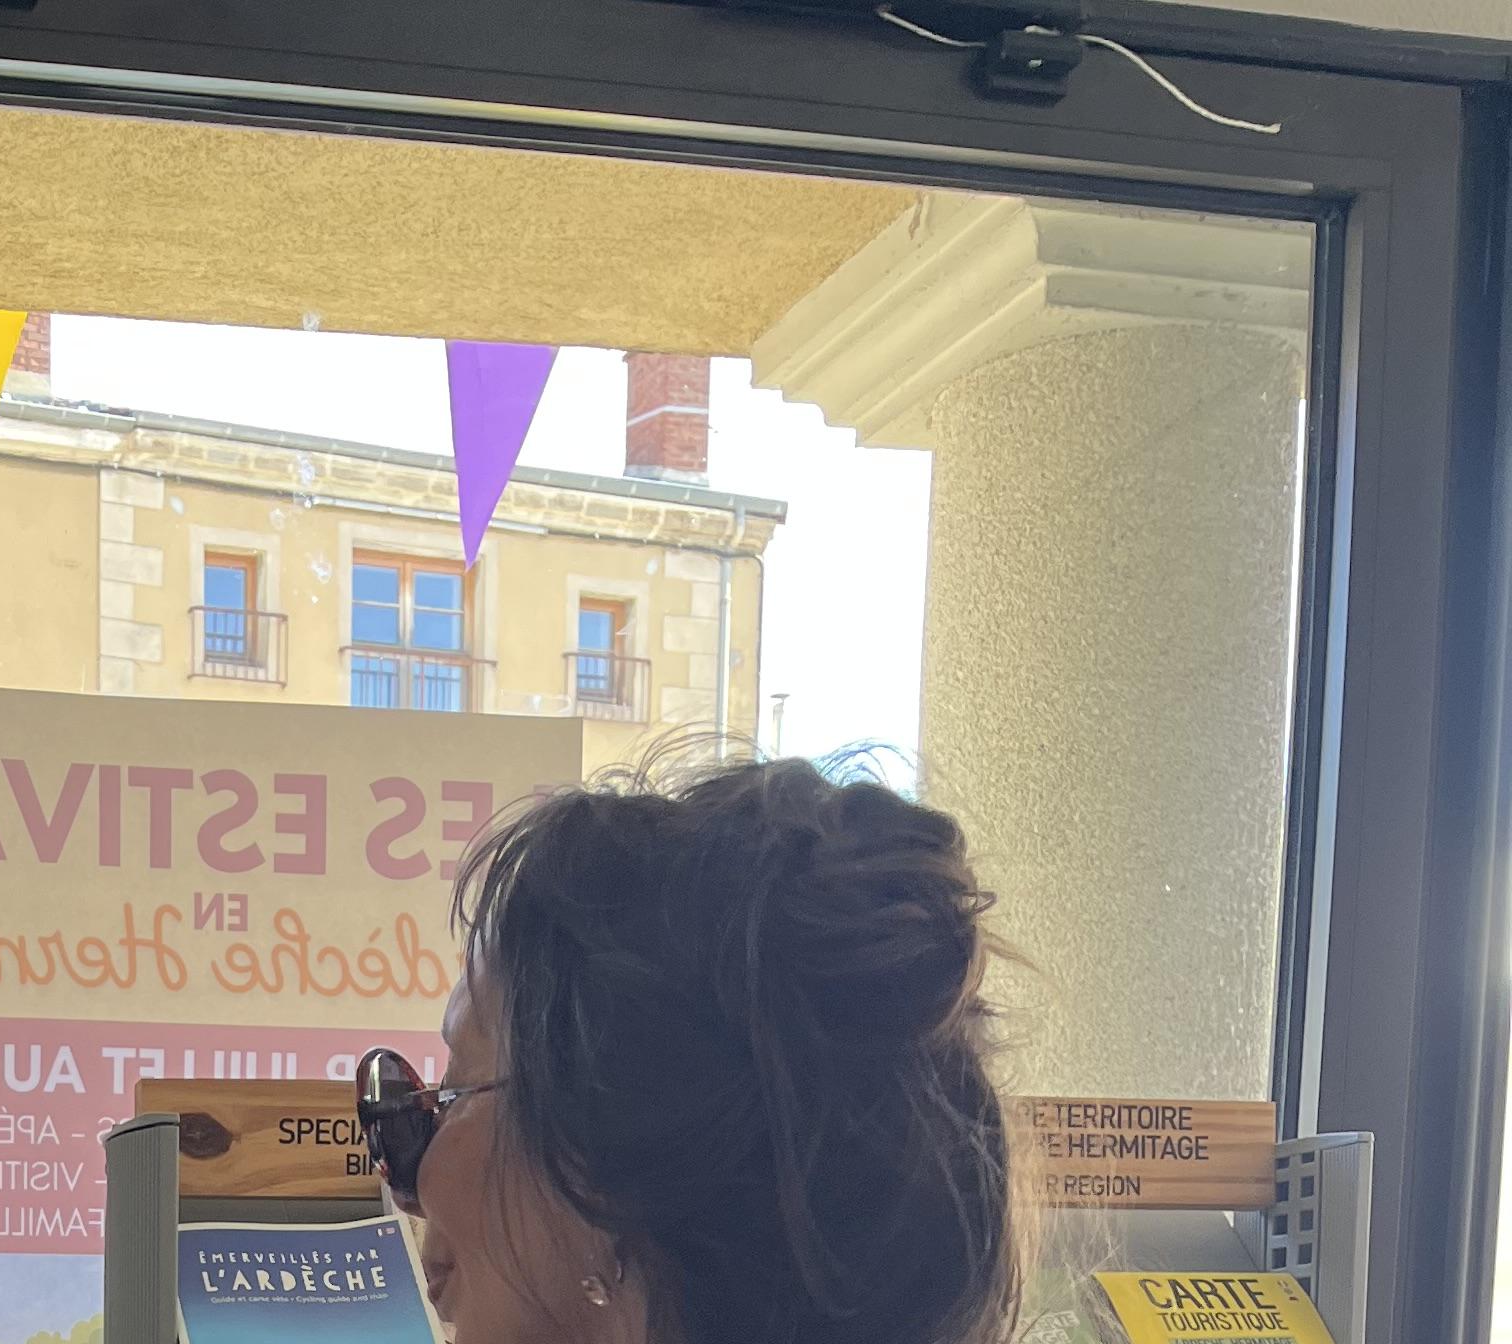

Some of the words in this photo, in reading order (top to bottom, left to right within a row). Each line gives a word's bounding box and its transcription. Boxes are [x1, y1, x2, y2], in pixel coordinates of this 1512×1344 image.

[1056, 1104, 1192, 1130] TERRITOIRE
[1068, 1134, 1209, 1160] HERMITAGE
[1064, 1176, 1141, 1196] REGION
[345, 1248, 379, 1263] PAR
[202, 1264, 387, 1294] L'ARDÈCHE
[1138, 1279, 1276, 1309] CARTE
[1158, 1312, 1289, 1332] TOURISTIQUE
